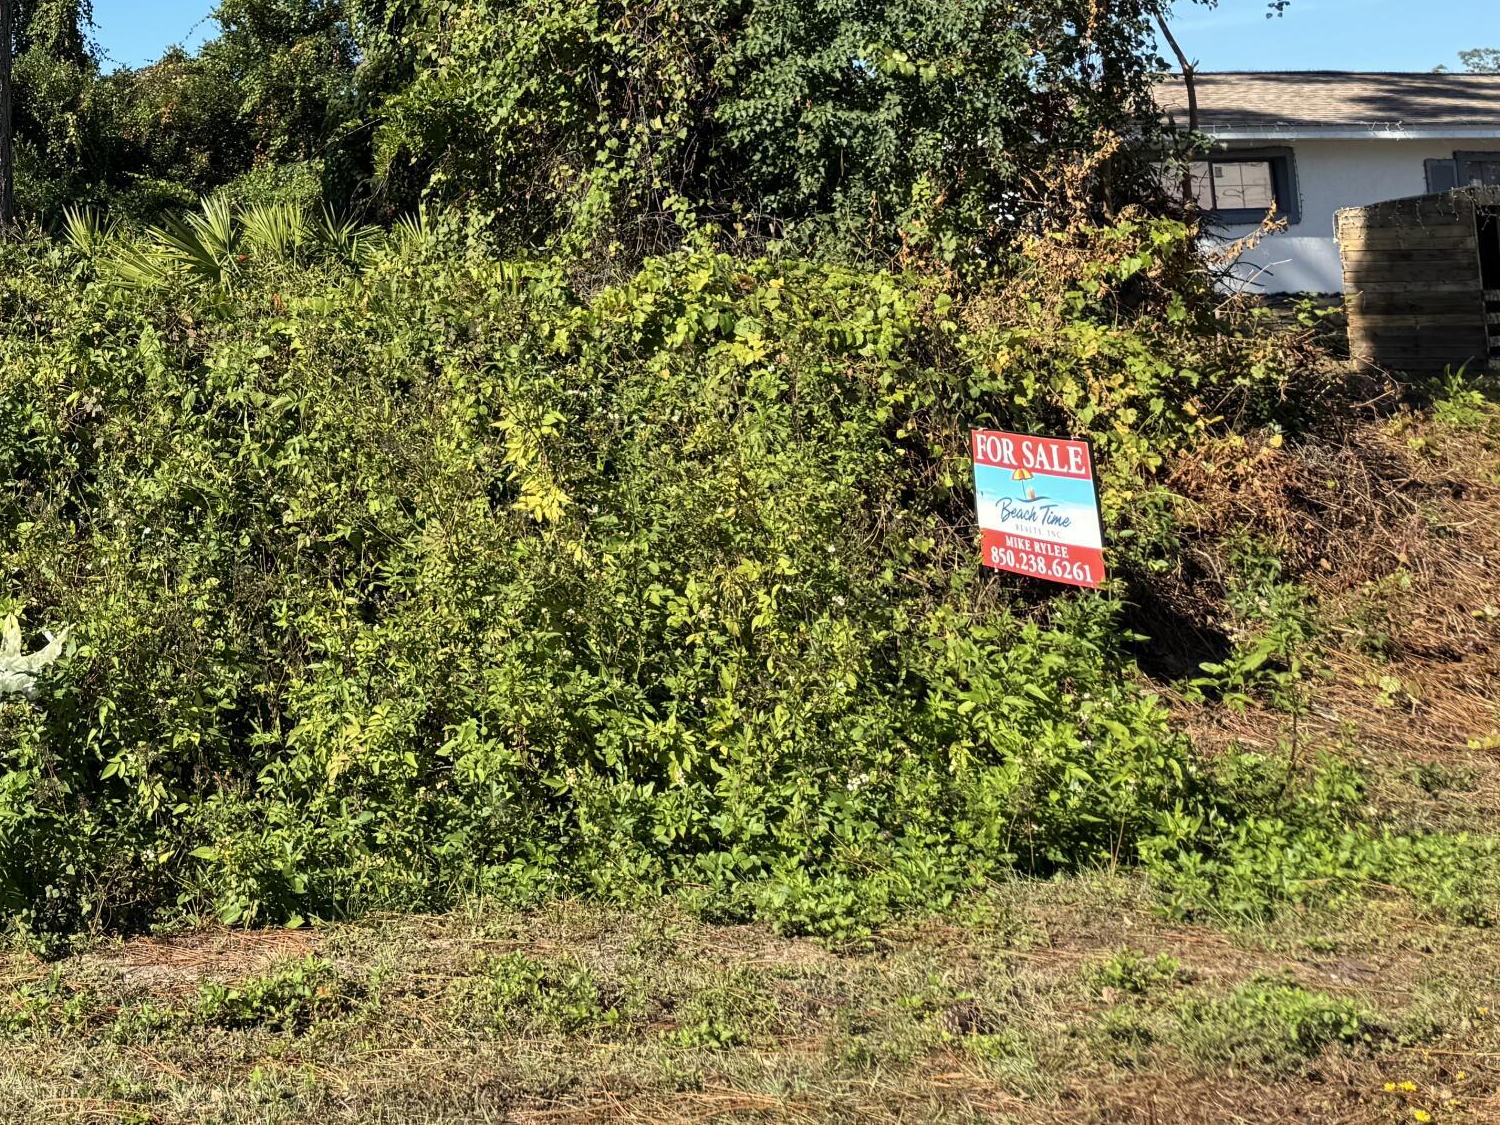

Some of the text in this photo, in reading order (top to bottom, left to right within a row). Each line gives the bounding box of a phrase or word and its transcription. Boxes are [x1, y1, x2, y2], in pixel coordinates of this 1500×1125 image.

[975, 433, 1086, 475] FOR SALE
[995, 496, 1072, 528] Beach Time
[1005, 535, 1069, 559] MIKE RYLEE
[990, 546, 1093, 583] 850.238.6261
